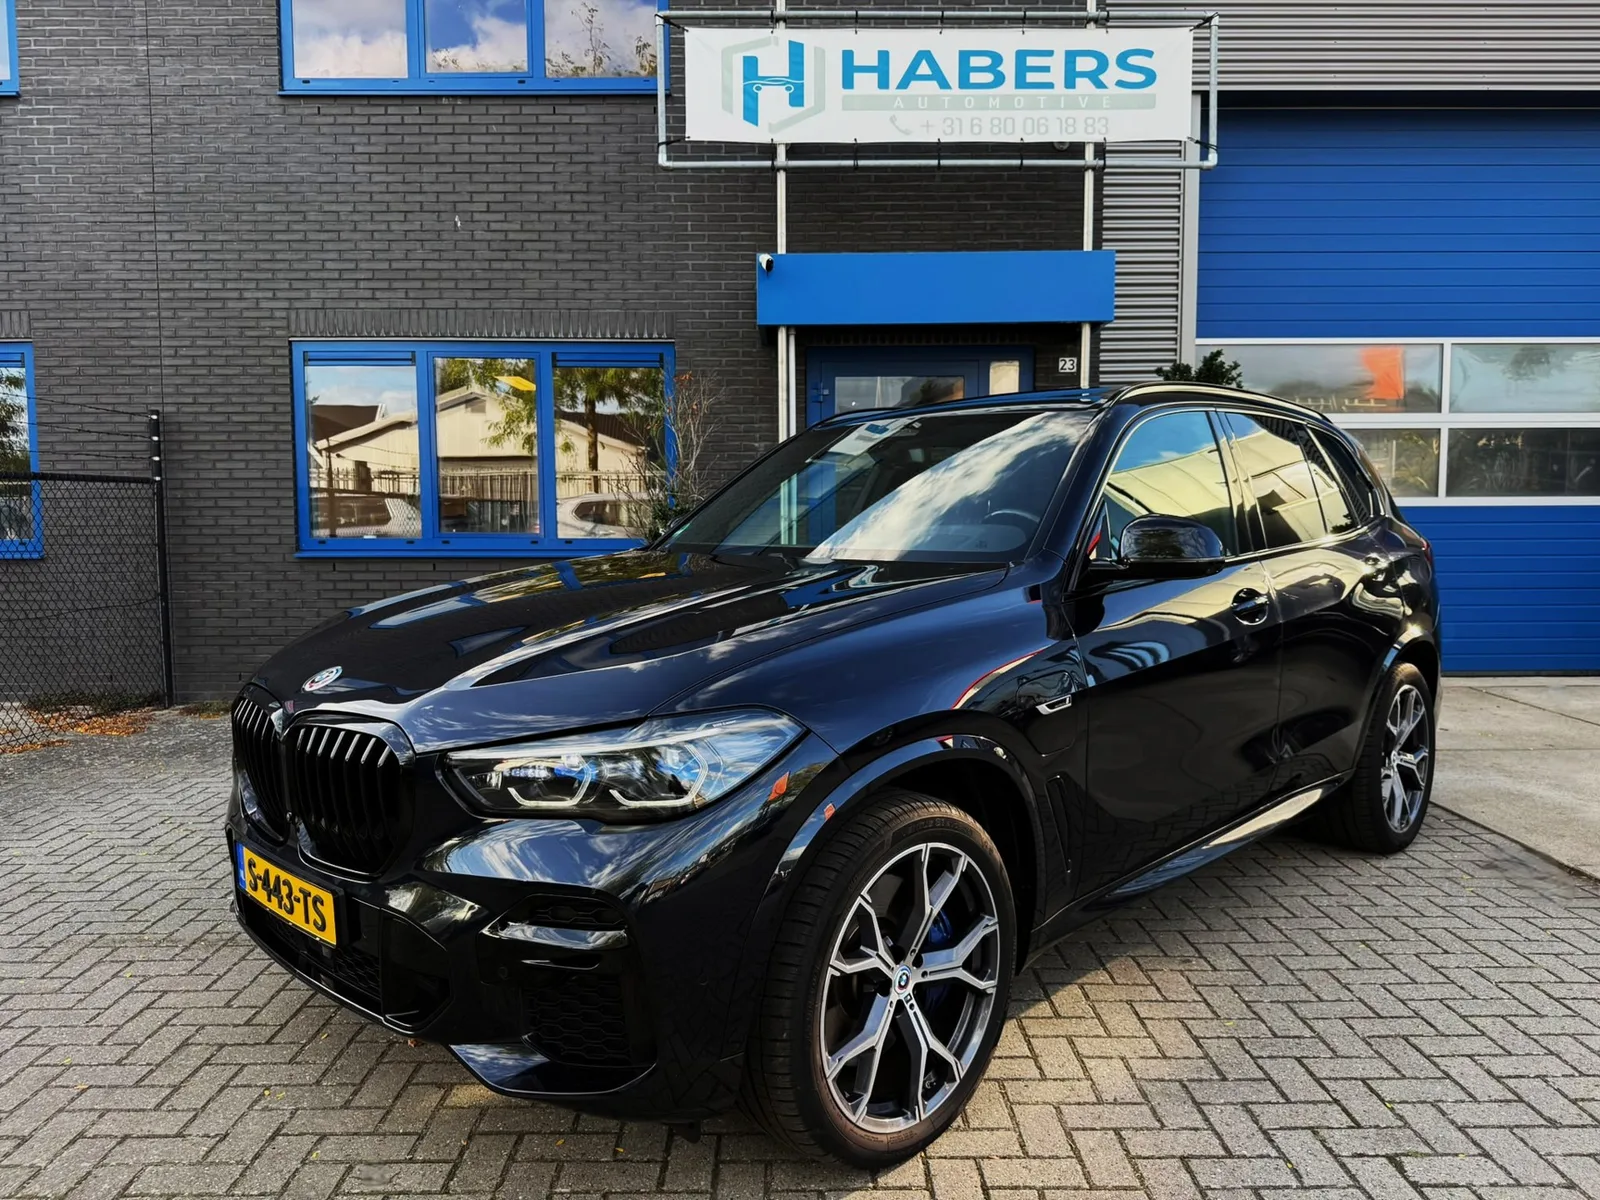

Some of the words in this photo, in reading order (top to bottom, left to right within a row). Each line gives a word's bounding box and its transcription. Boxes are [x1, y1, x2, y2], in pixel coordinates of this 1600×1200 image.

[841, 48, 1157, 90] HABERS
[893, 95, 1111, 109] AUTOMOTIVE
[990, 116, 1016, 136] 80
[1022, 116, 1049, 136] 06
[1056, 116, 1077, 136] 18
[1084, 116, 1109, 136] 83
[1060, 359, 1075, 371] 23
[247, 857, 327, 932] S-443-TS
